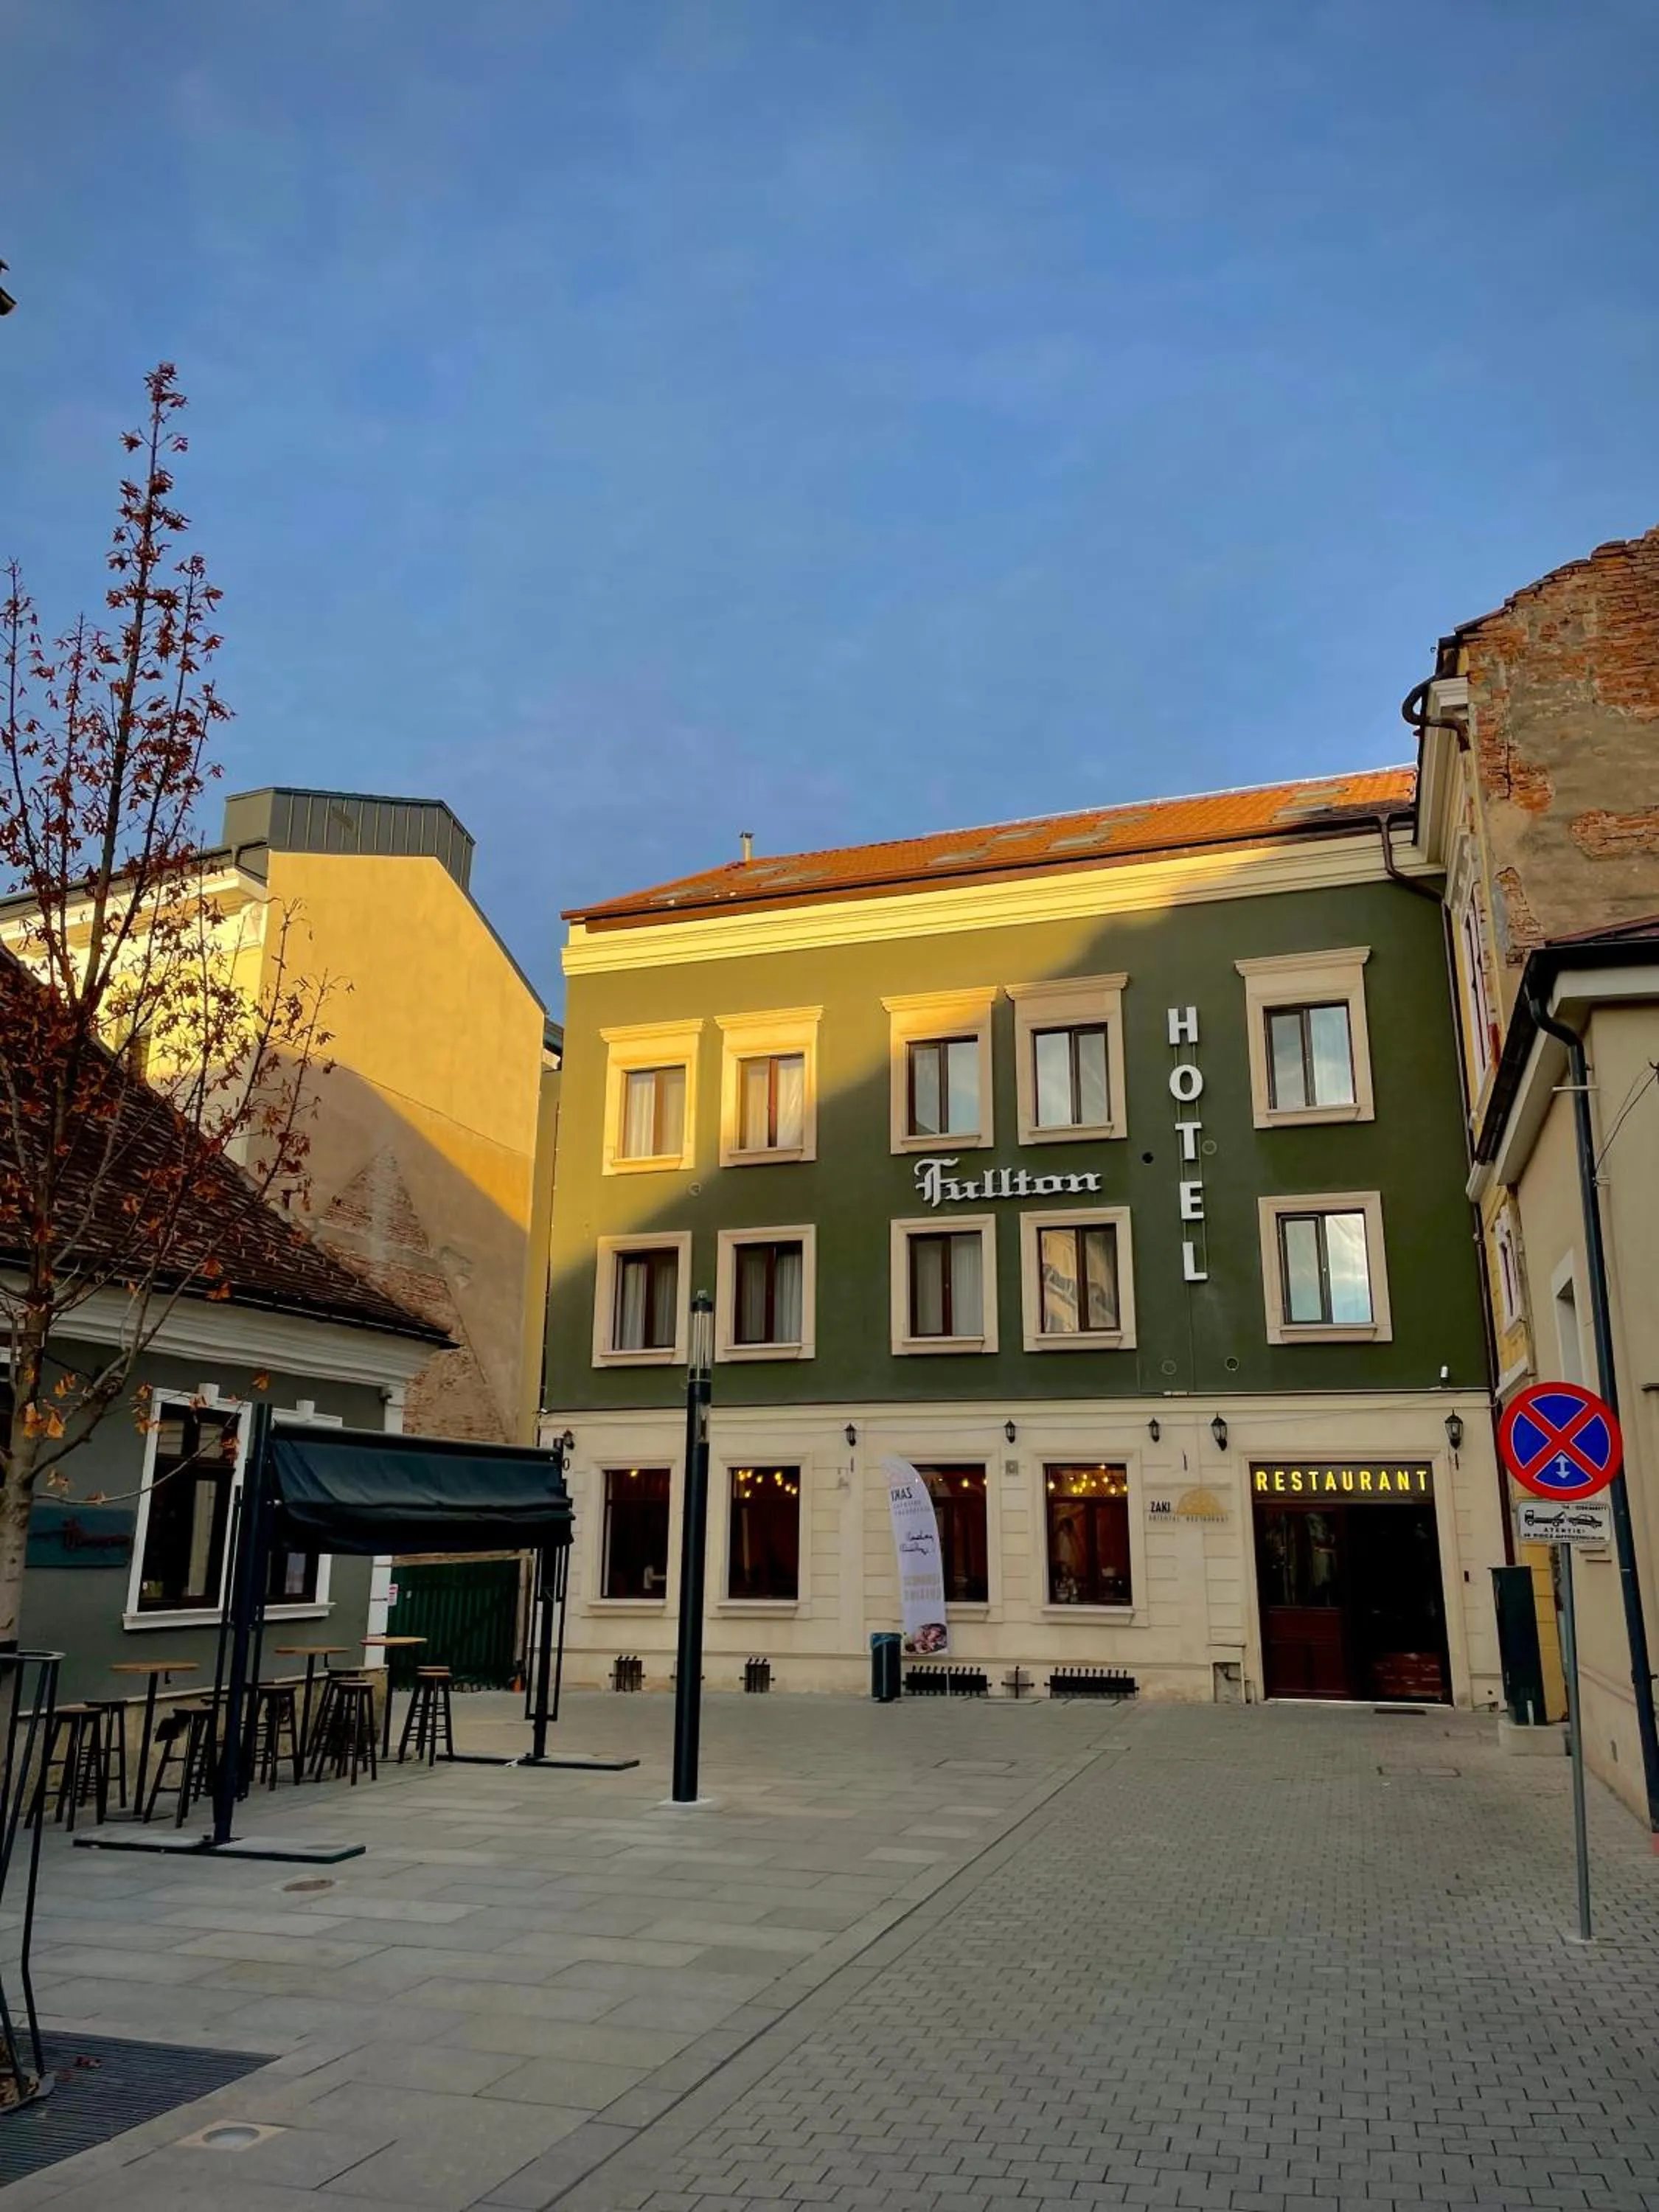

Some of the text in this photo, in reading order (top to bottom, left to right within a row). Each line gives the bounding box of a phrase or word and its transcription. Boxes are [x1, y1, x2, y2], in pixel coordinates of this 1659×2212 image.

[1168, 1006, 1208, 1281] HOTEL
[914, 1157, 1102, 1207] Fullton
[1256, 1470, 1427, 1491] RESTAURANT
[1150, 1501, 1171, 1513] ZAKI
